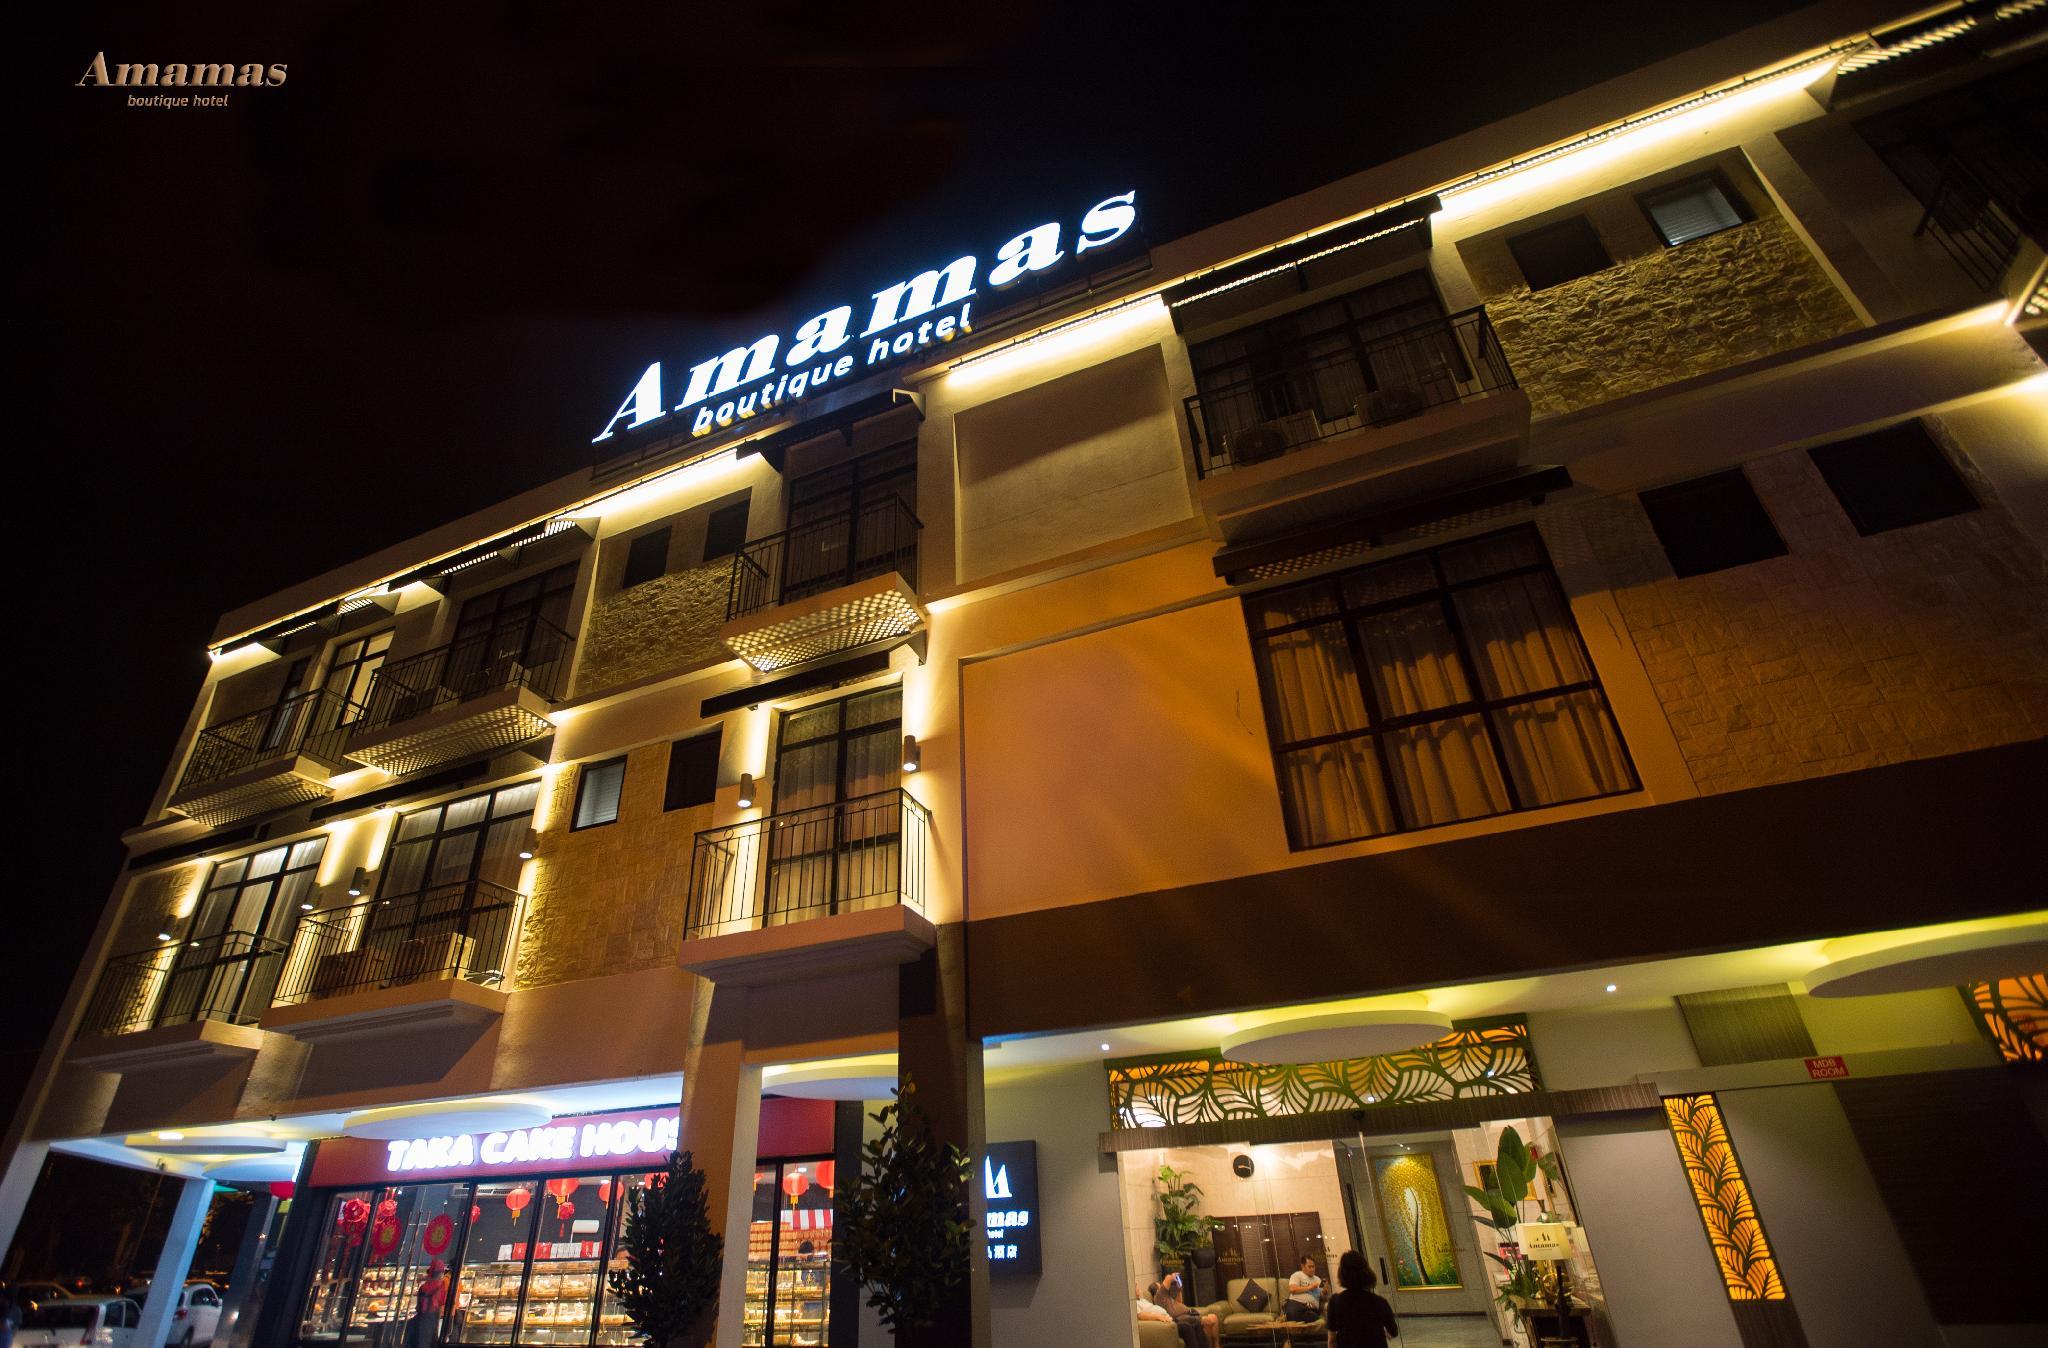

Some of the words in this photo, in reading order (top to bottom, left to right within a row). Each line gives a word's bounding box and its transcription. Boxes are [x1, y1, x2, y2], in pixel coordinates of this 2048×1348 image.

[592, 190, 1137, 443] Amamas
[691, 354, 855, 434] boutique
[867, 302, 971, 365] hotel
[1812, 1067, 1846, 1077] ROOM
[387, 1134, 474, 1171] TAKA
[480, 1126, 577, 1163] CAKE
[580, 1117, 680, 1158] HOUS
[986, 1210, 1029, 1227] mas
